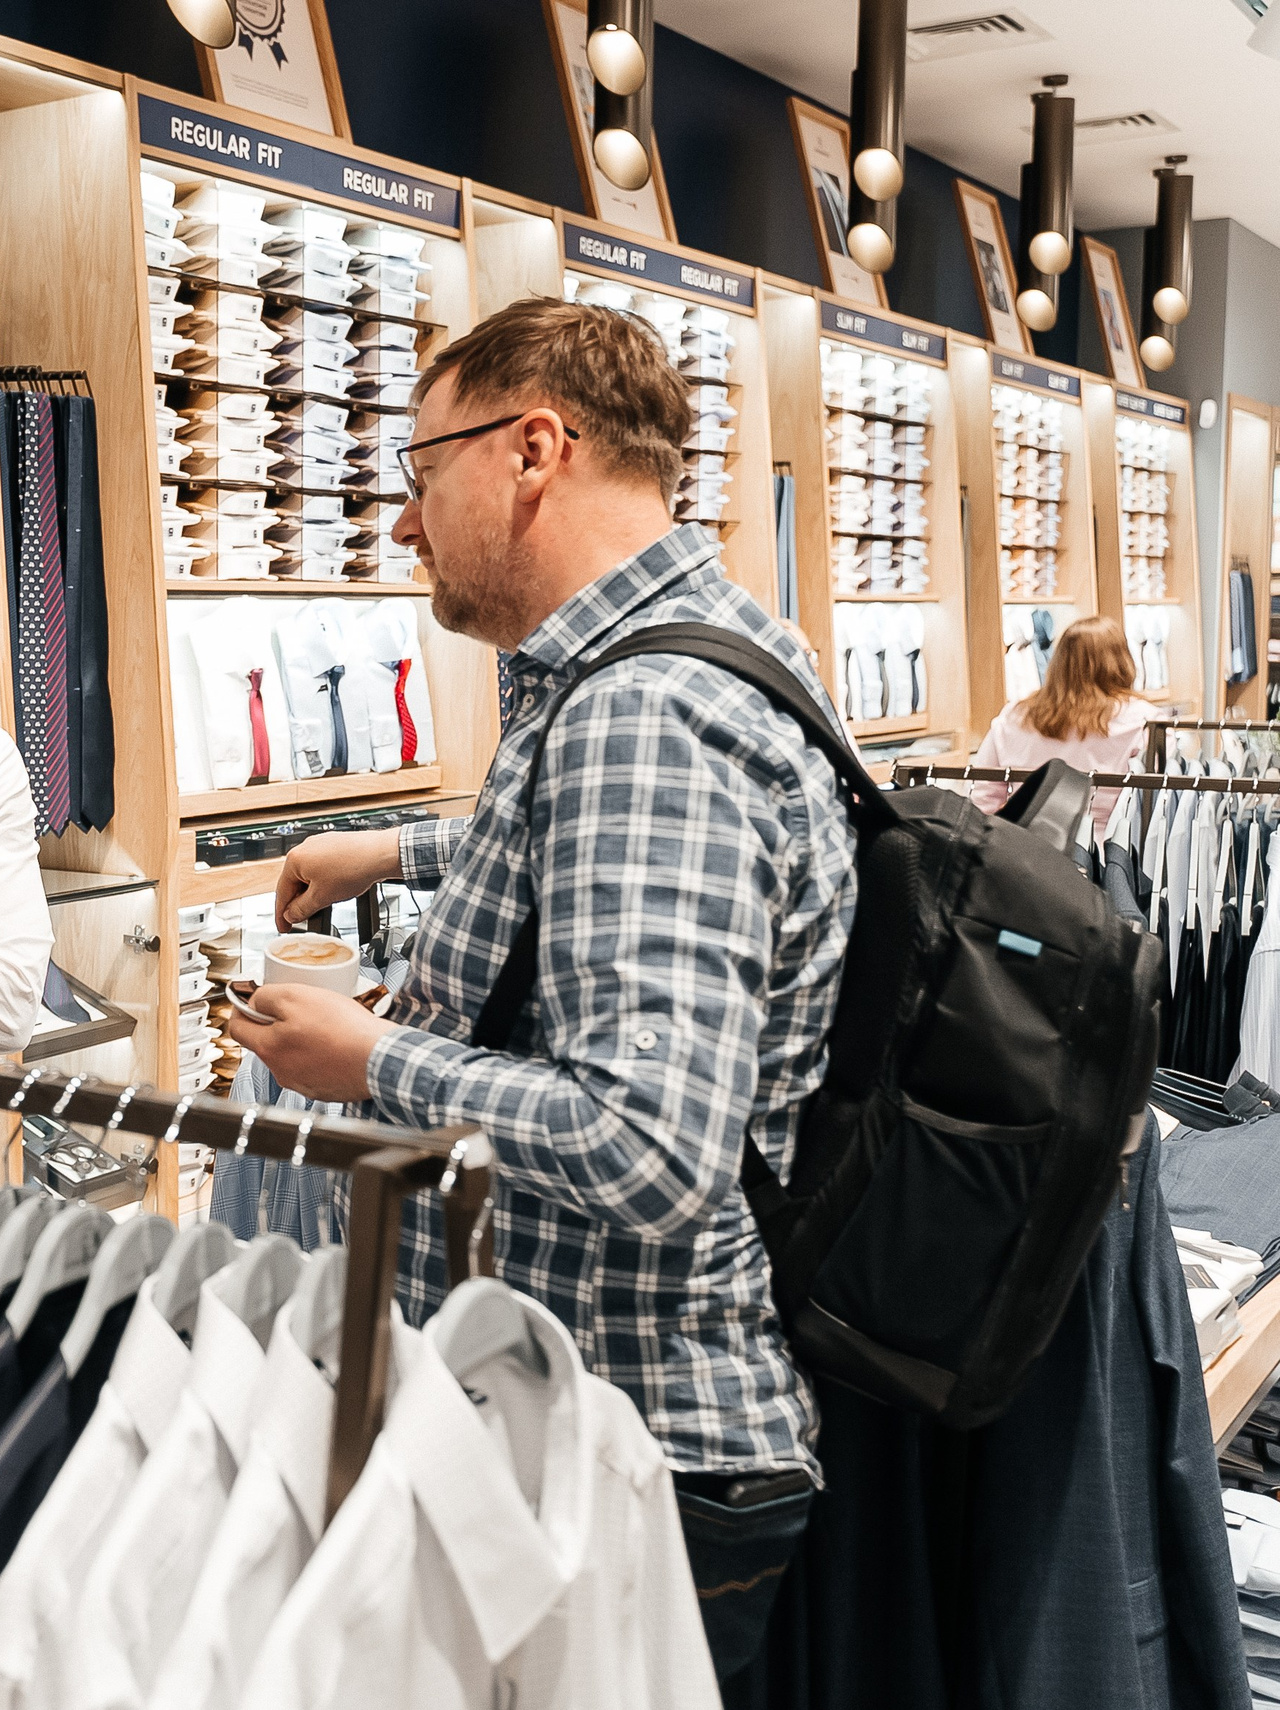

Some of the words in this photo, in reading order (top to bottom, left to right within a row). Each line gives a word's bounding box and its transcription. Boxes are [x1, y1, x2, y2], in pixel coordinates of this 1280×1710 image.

[170, 116, 251, 161] REGULAR
[257, 142, 283, 169] FIT
[343, 167, 409, 205] REGULAR
[413, 188, 435, 212] FIT
[579, 236, 628, 266] REGULAR
[630, 250, 647, 271] FIT
[680, 265, 723, 293] REGULAR
[724, 278, 739, 297] FIT
